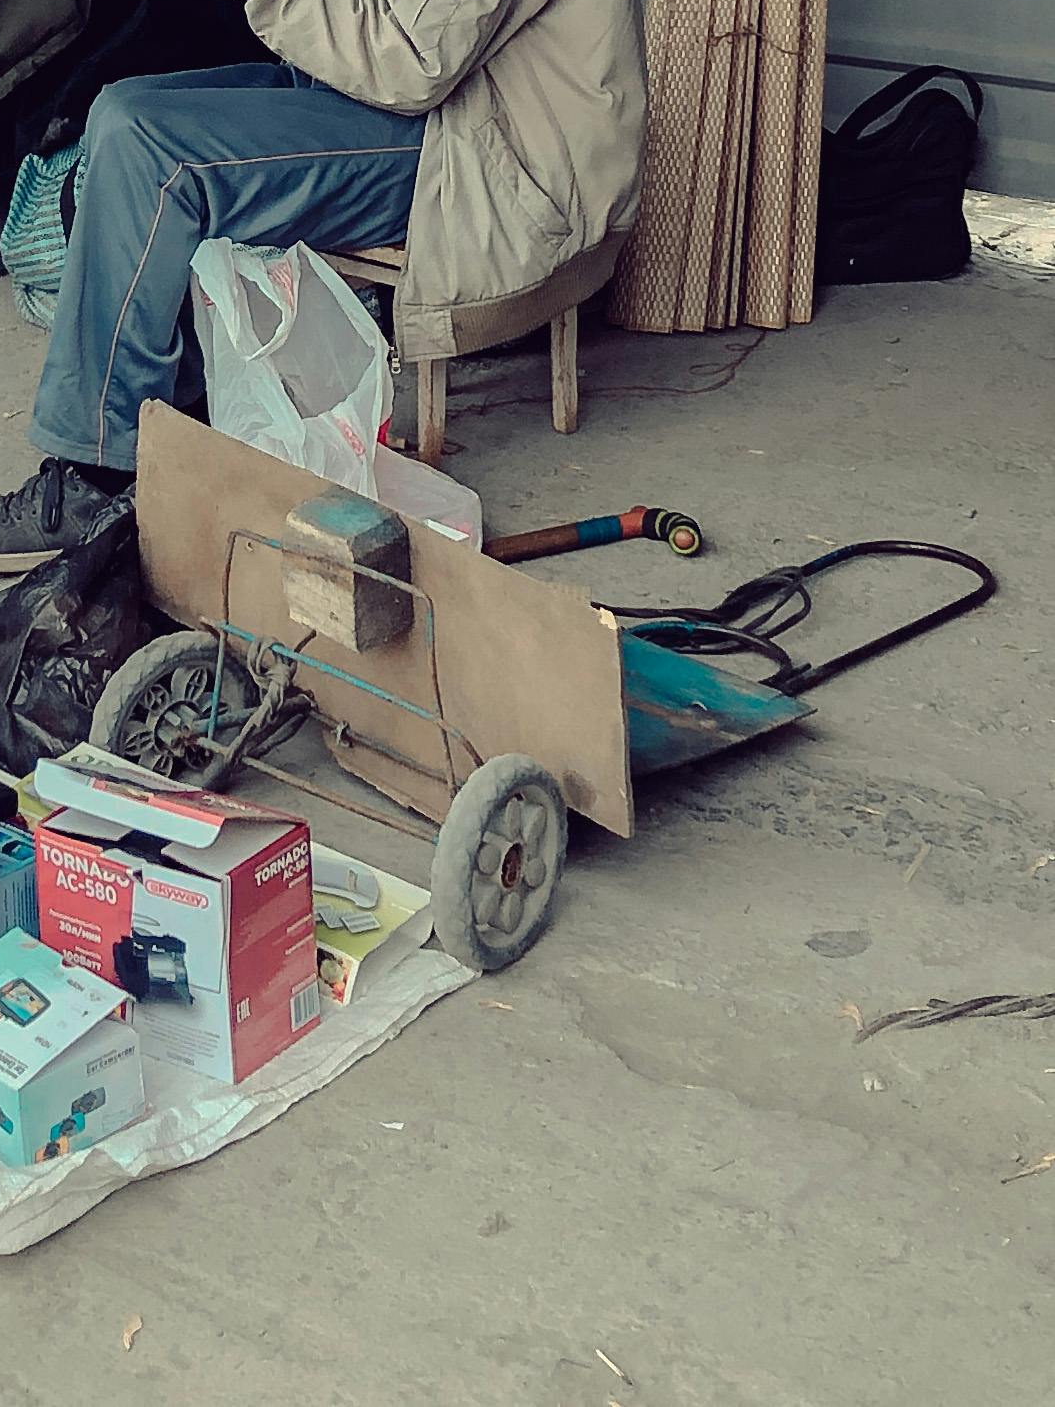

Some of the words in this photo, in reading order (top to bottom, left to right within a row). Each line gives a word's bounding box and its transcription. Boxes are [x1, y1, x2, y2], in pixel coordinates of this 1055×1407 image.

[40, 843, 131, 887] TORNADO
[254, 841, 309, 887] TORNADO
[57, 873, 117, 905] AC-580
